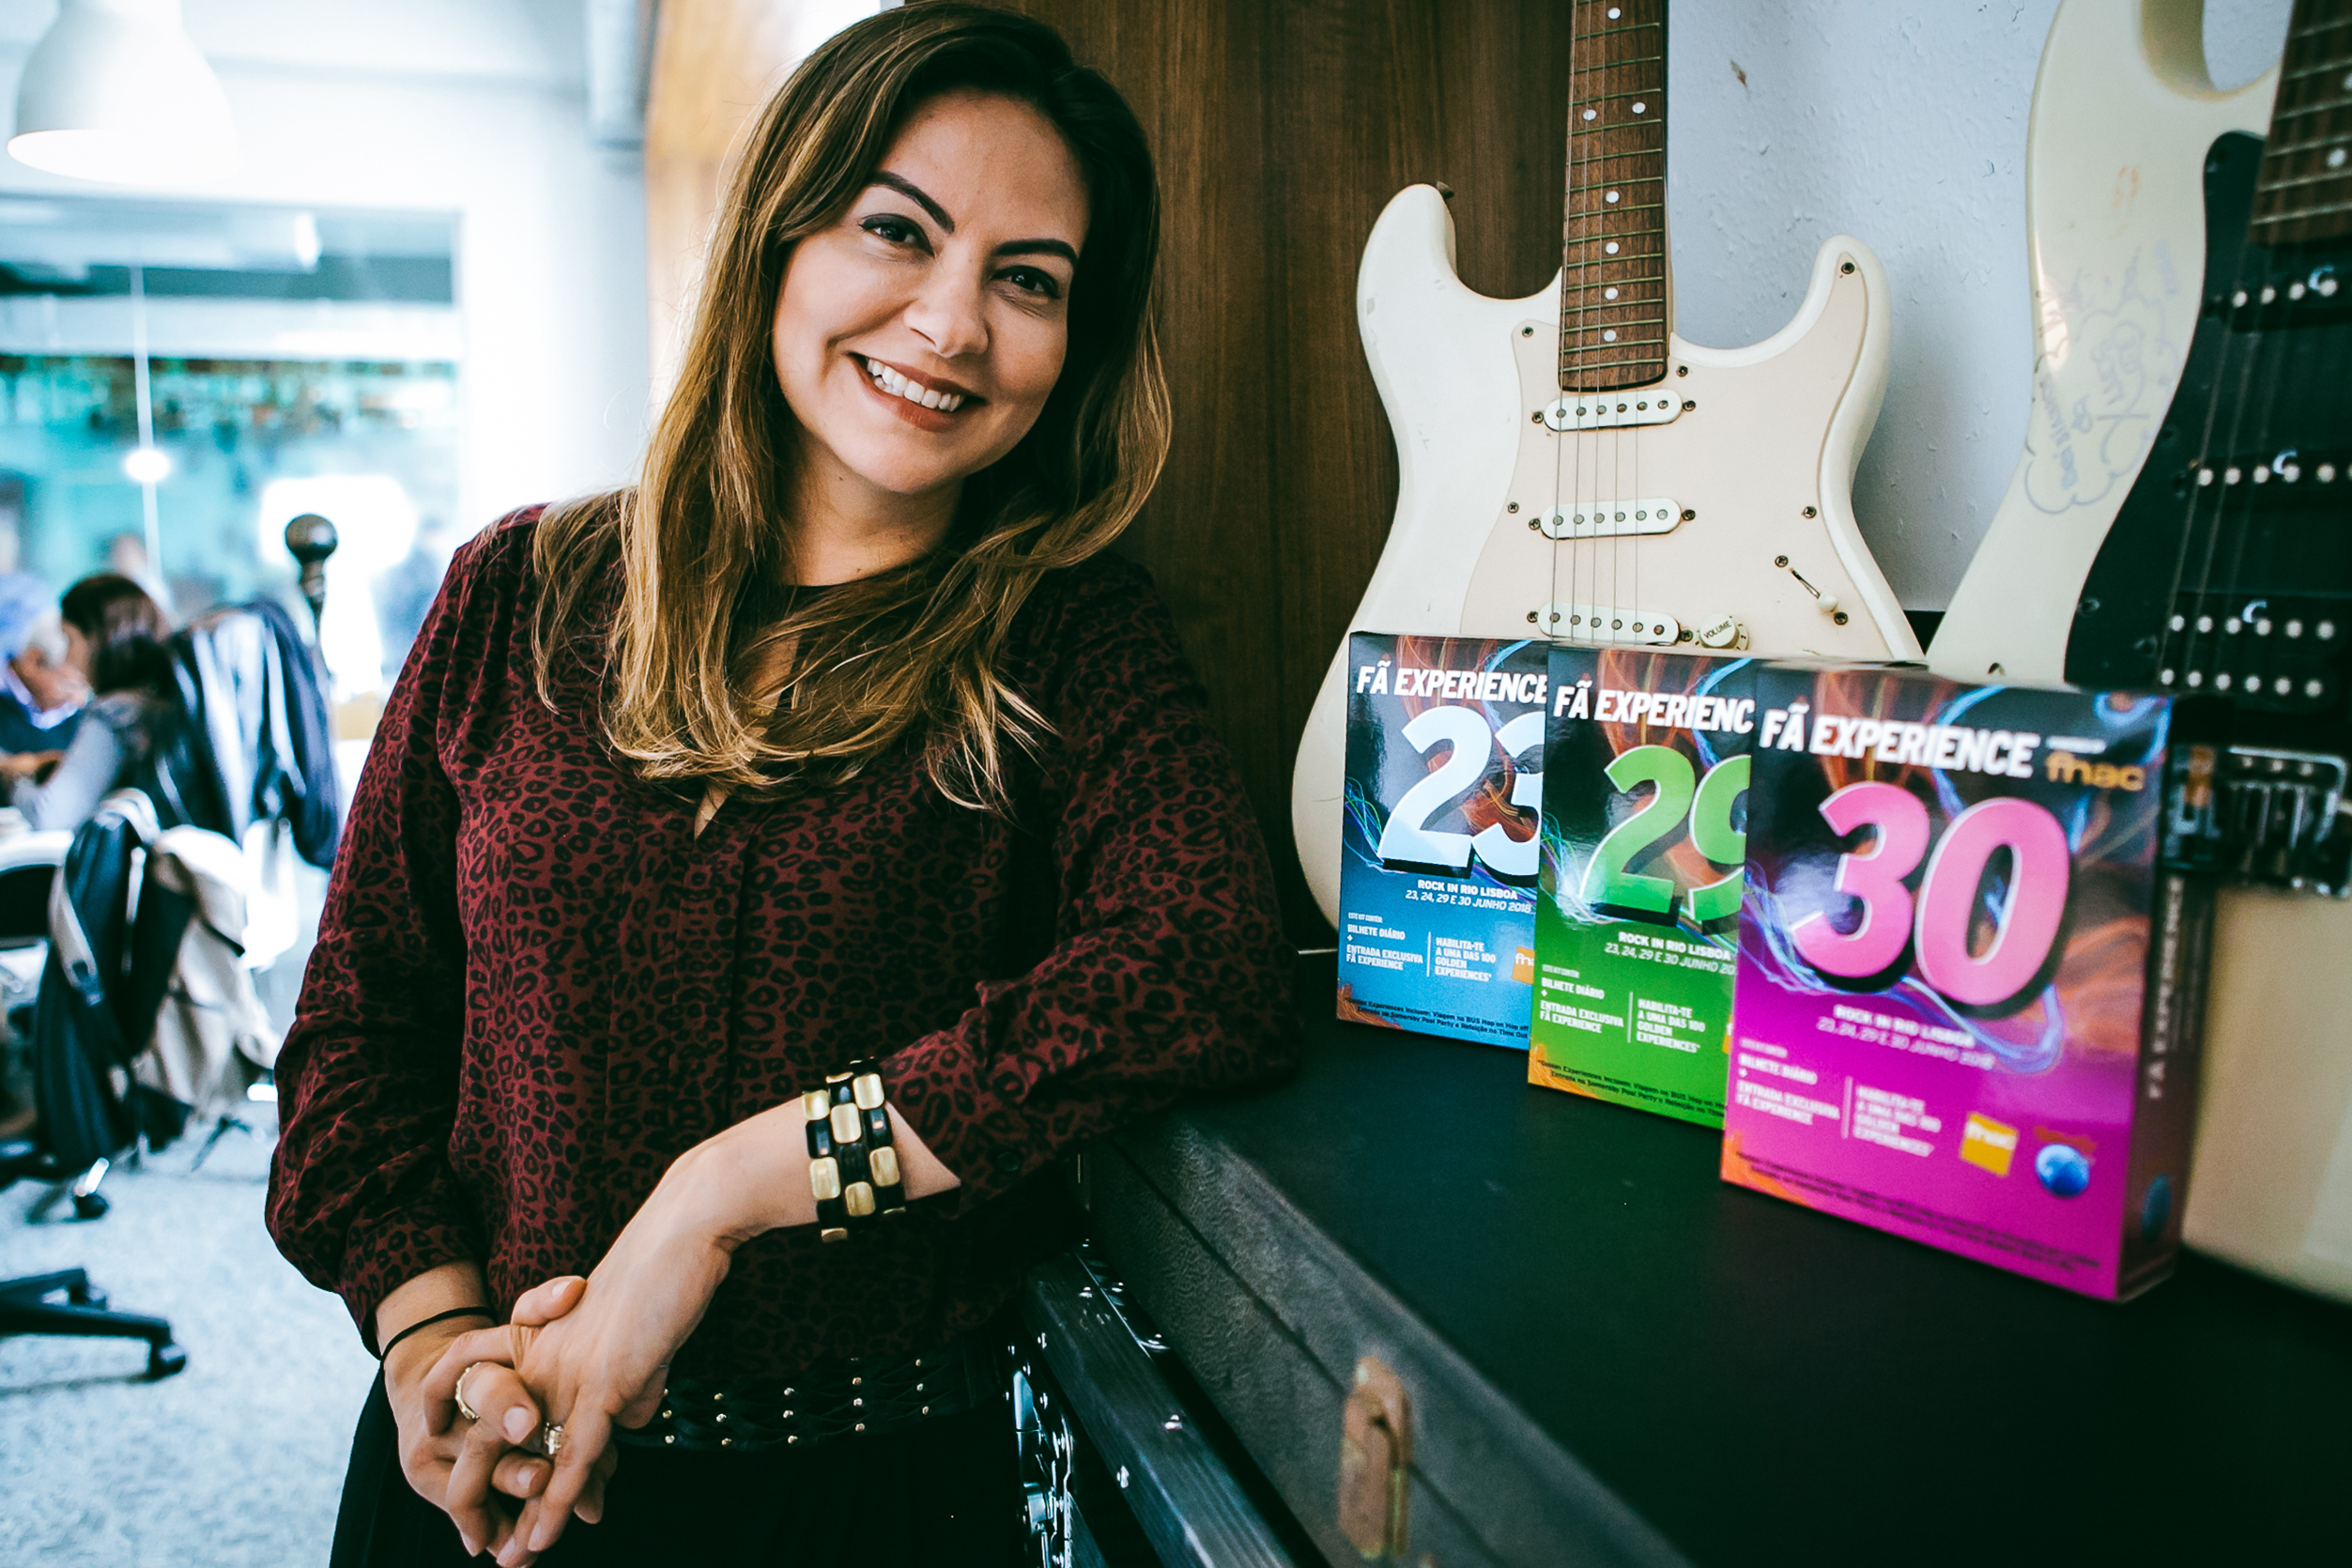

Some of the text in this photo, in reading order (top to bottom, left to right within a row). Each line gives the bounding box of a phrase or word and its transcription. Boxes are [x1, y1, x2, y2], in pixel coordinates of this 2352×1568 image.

[1703, 621, 1731, 639] VOLUME
[1356, 660, 1547, 704] FÃ EXPERIENCE
[1553, 680, 1592, 719] FÃ
[1759, 702, 2041, 779] FÃ EXPERIENCE
[2045, 751, 2146, 792] fnac
[1376, 705, 1545, 877] 23
[1418, 880, 1517, 900] ROCK IN RIO LISBOA
[1788, 779, 2071, 1008] 30
[1405, 890, 1532, 914] 23, 24, 29 E 30 JUNHO 2018
[1347, 924, 1406, 941] BILHETE DIÁRIO
[1346, 945, 1423, 964] ENTRADA EXCLUSIVA
[1436, 937, 1485, 952] HABILITA-TE
[1619, 931, 1731, 961] ROCK IN RIO LISBOA
[1346, 950, 1404, 971] FÃ EXPERIENCE
[1435, 956, 1468, 969] GOLDEN
[1443, 948, 1463, 960] UMA
[1463, 952, 1480, 961] DAS
[1482, 953, 1497, 963] 100
[1605, 943, 1620, 955] 23,
[1622, 946, 1637, 960] 24,
[1638, 948, 1654, 960] 29
[1654, 951, 1663, 962] E
[1664, 952, 1679, 965] 30
[1679, 956, 1718, 973] JUNHO
[1542, 977, 1606, 999] BILHETE DIÁRIO
[1467, 1016, 1481, 1024] BUS
[1540, 999, 1624, 1028] ENTRADA EXCLUSIVA
[1637, 999, 1693, 1020] HABILITA-TE
[1637, 1010, 1645, 1020] A
[1647, 1012, 1667, 1025] UMA
[1668, 1016, 1687, 1029] DAS
[1540, 1007, 1603, 1034] FÃ EXPERIENCE
[1637, 1021, 1673, 1037] GOLDEN
